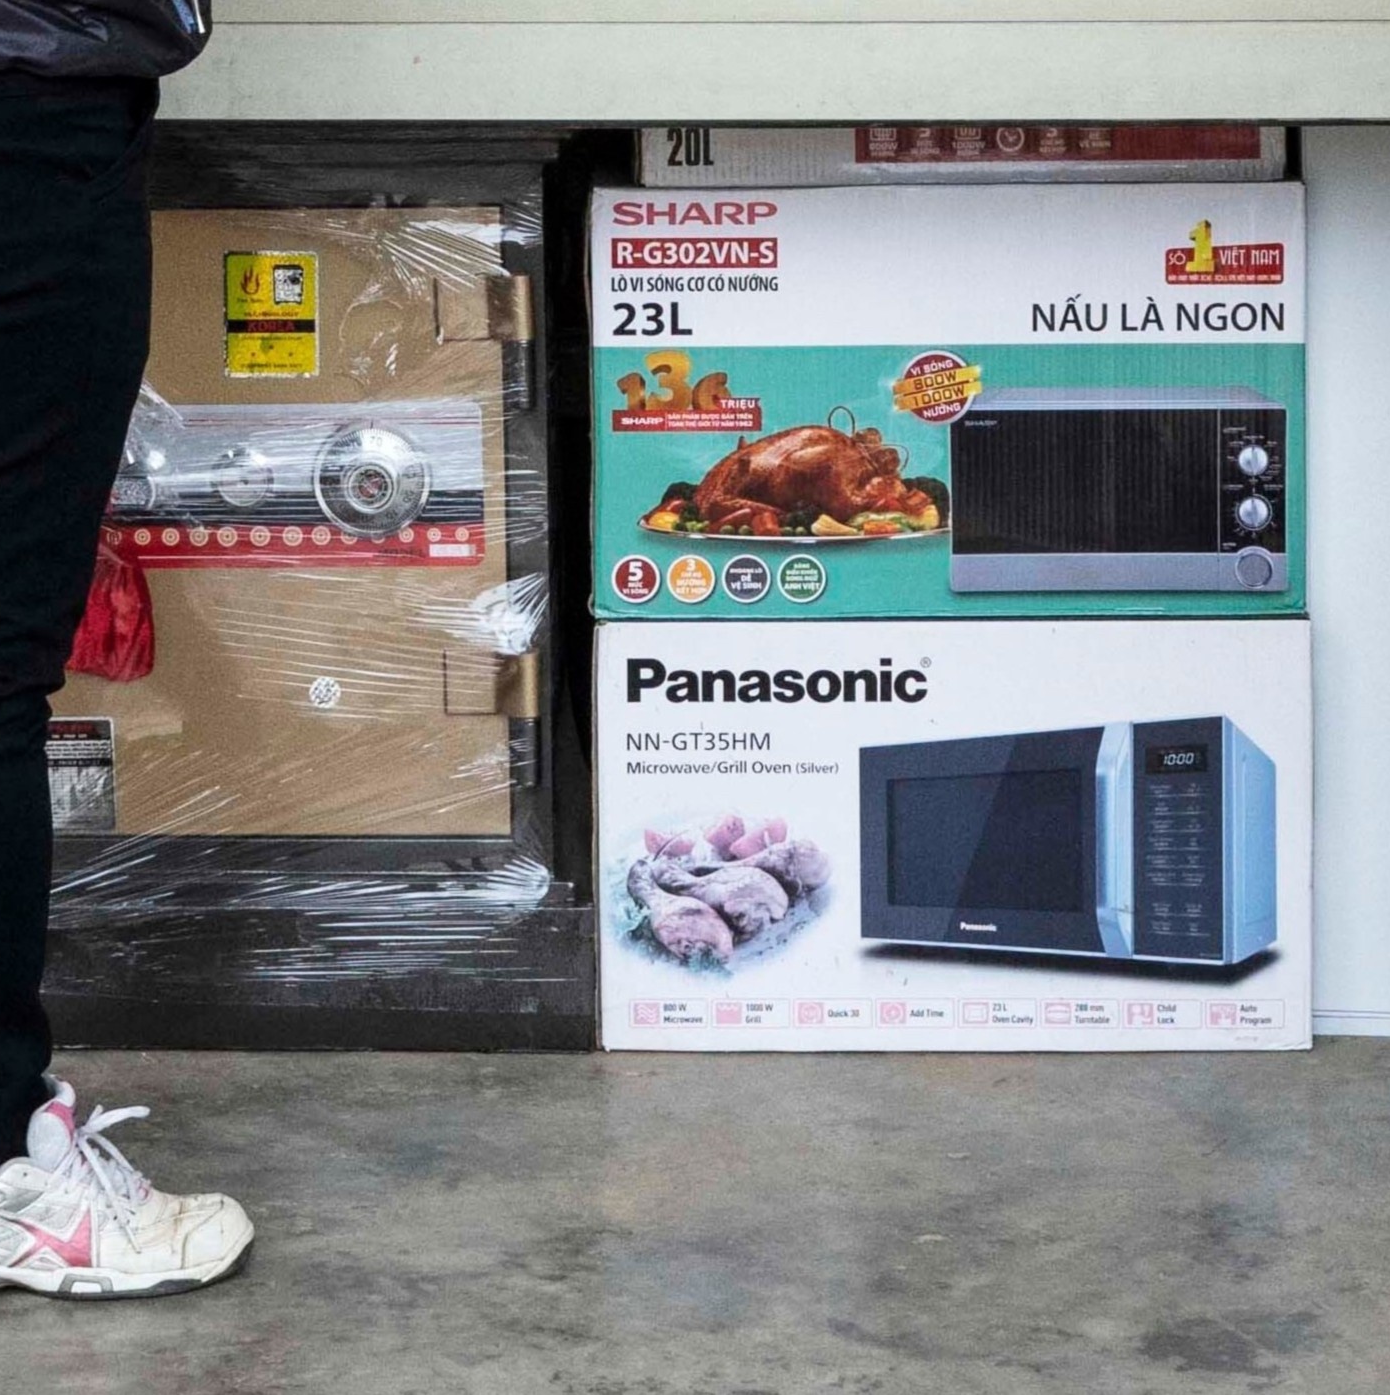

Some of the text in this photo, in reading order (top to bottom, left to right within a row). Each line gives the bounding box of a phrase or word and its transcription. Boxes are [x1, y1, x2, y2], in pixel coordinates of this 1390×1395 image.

[667, 127, 714, 166] 20L
[612, 201, 778, 226] SHARP
[616, 241, 774, 265] R-G302VN-S
[1250, 249, 1280, 265] NAM
[611, 274, 627, 292] LÒ
[630, 277, 643, 292] VI
[647, 274, 684, 292] SÓNG
[707, 274, 725, 292] CÓ
[728, 273, 778, 292] NƯỚNG
[612, 301, 693, 336] 23L
[1032, 294, 1284, 332] NẤU LÀ NGON
[910, 359, 954, 376] VI SÓNG
[913, 370, 957, 390] 800W
[914, 384, 965, 407] 1000W
[720, 399, 755, 410] TRIỆU
[621, 417, 664, 425] SHARP
[628, 561, 643, 582] 5
[627, 658, 928, 704] Panasonic
[626, 732, 771, 751] NN-GT35HM
[627, 761, 839, 774] Microwave/Grill Oven (Silver)
[960, 922, 997, 932] Panasonic
[828, 1009, 849, 1018] Quick
[909, 1009, 944, 1017] Add Time
[1157, 1004, 1176, 1012] Child
[1240, 1004, 1257, 1013] Auto
[663, 1015, 703, 1024] Microwave
[746, 1015, 761, 1024] Grill
[992, 1015, 1033, 1026] Oven Cavity
[1075, 1015, 1110, 1024] Turntable
[1157, 1016, 1175, 1024] Lock
[1240, 1015, 1272, 1026] Program
